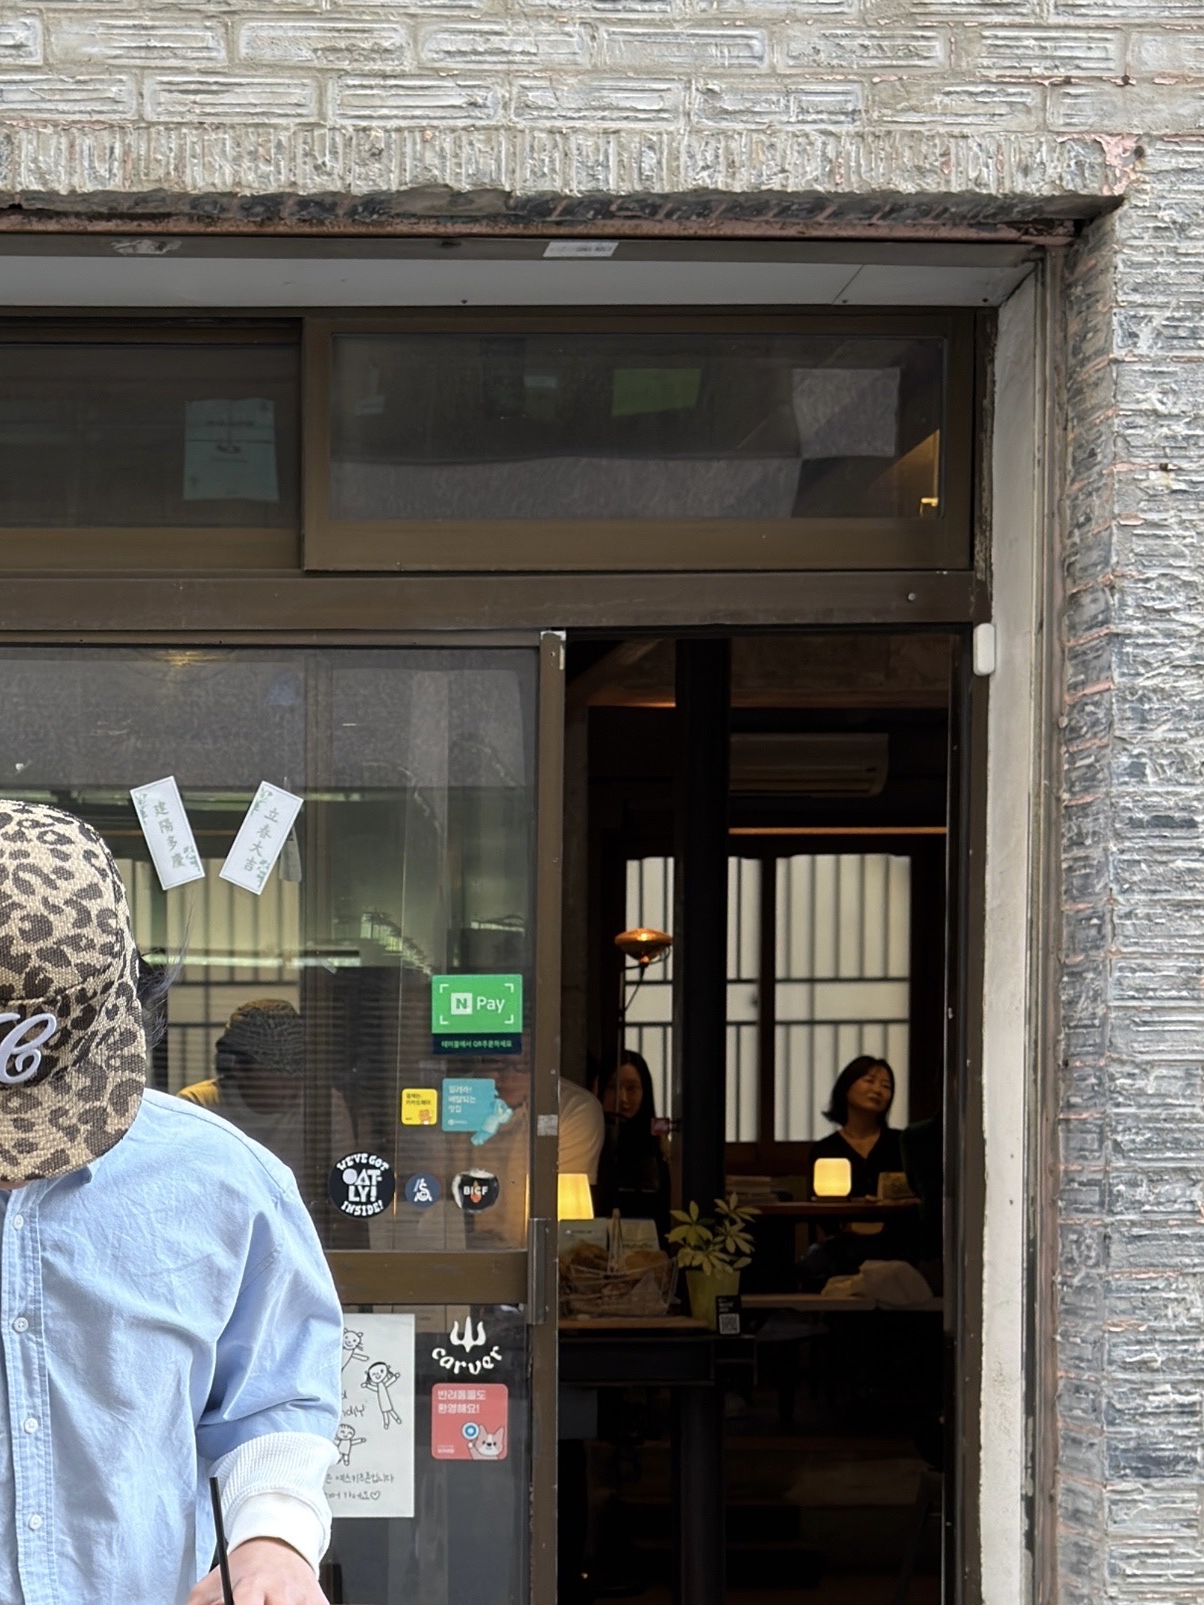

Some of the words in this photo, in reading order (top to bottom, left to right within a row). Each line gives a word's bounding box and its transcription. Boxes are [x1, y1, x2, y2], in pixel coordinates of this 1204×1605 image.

[243, 807, 280, 872] 立春大吉
[476, 996, 505, 1013] Pay
[369, 1154, 390, 1172] GOT
[340, 1200, 384, 1217] INSIDE!
[432, 1345, 502, 1375] carver
[437, 1389, 486, 1401] 반려동물도
[438, 1403, 480, 1414] 환영해요!
